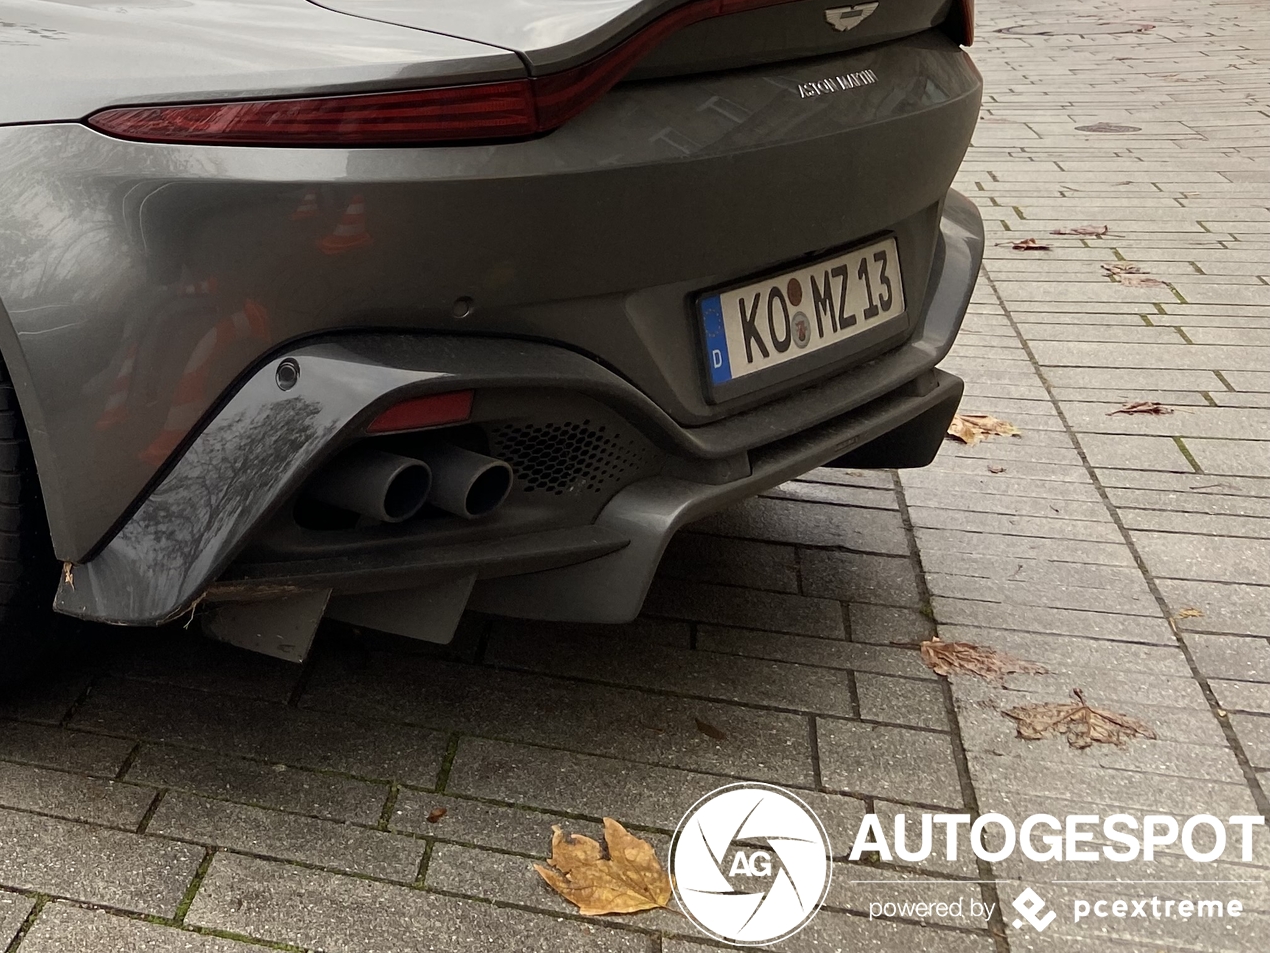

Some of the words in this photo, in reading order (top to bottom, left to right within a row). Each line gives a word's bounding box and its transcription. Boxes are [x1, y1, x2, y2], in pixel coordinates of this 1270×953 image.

[798, 78, 839, 98] ASTON
[836, 69, 879, 90] MARTIN
[739, 286, 792, 363] KO
[810, 264, 857, 338] MZ
[858, 250, 893, 320] 13
[712, 349, 723, 369] D
